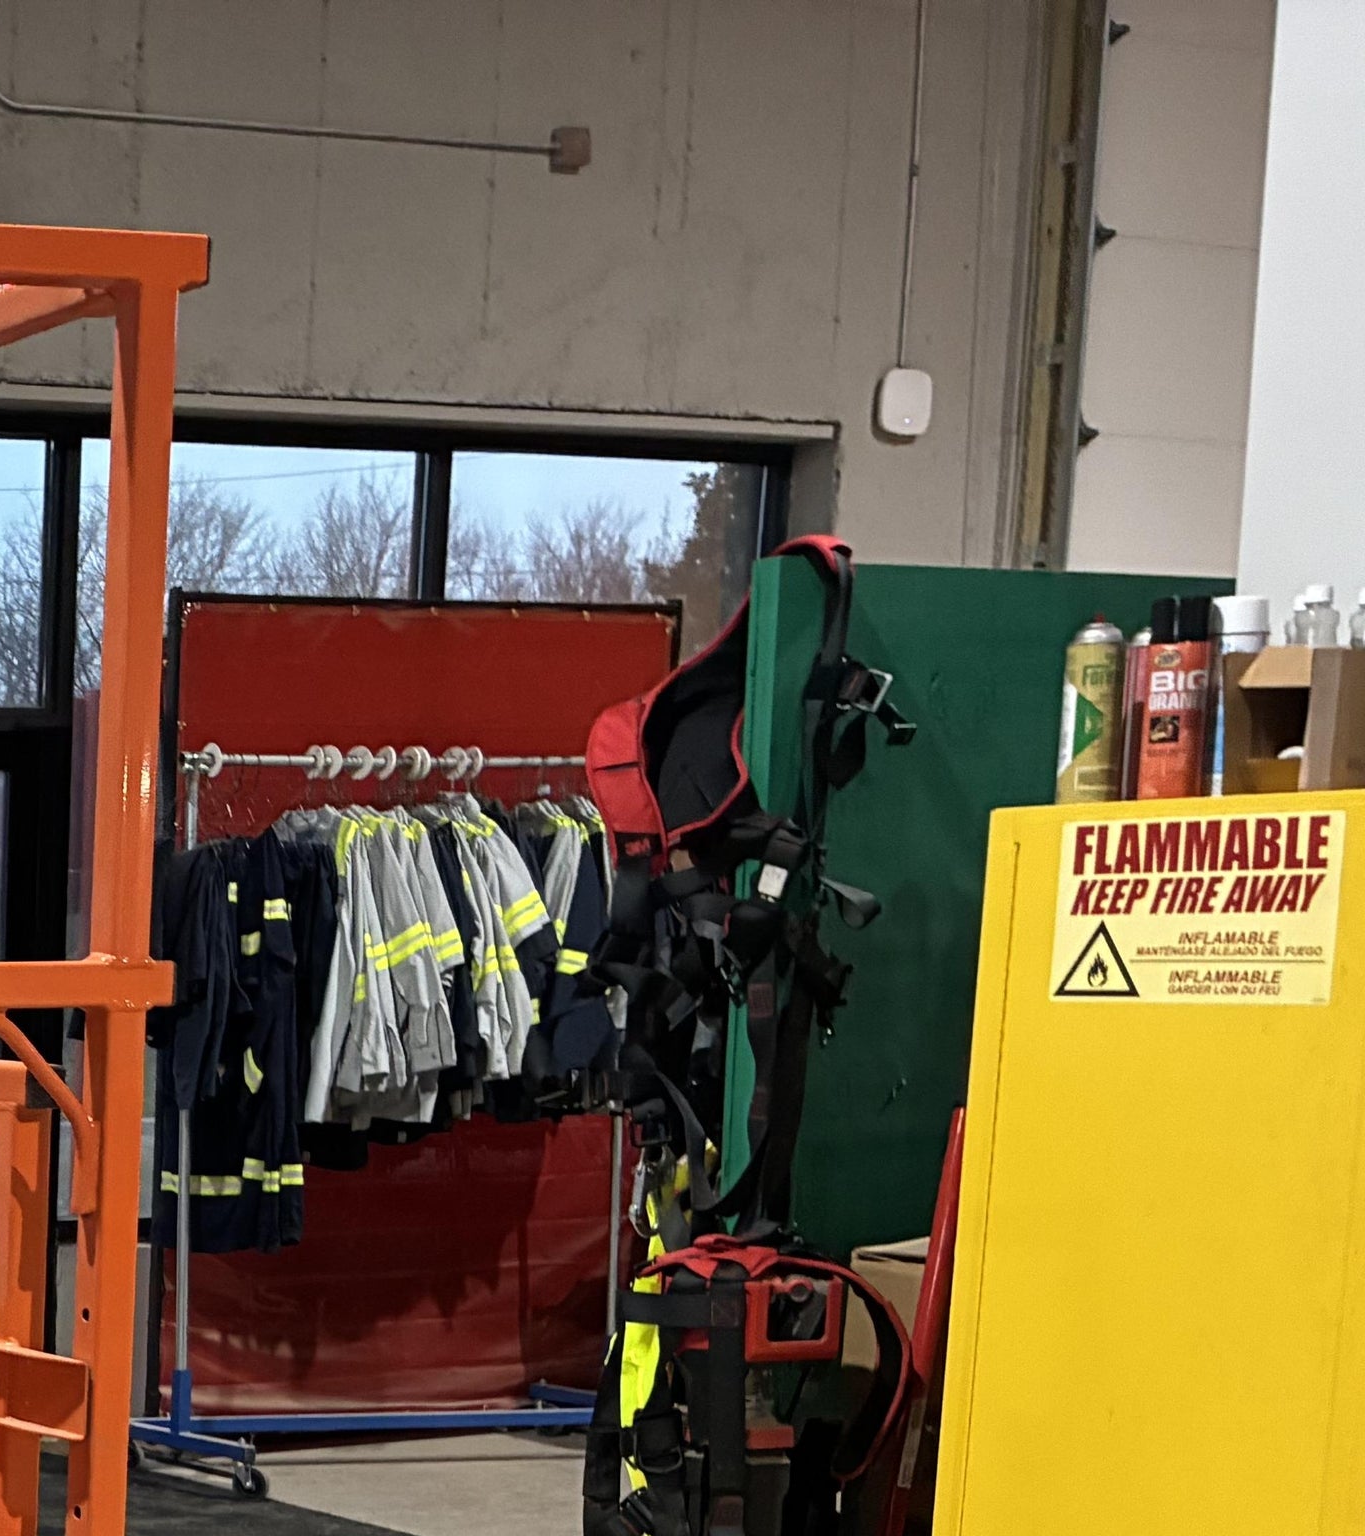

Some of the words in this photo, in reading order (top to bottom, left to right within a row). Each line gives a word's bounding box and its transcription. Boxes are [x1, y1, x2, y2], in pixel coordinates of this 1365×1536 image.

[1148, 690, 1199, 711] ORAN
[1073, 815, 1330, 876] FLAMMABLE
[1070, 879, 1149, 915] KEEP
[1150, 876, 1223, 914] FIRE
[1221, 874, 1326, 913] AWAY
[1178, 931, 1279, 945] INFLAMABLE
[1209, 946, 1258, 956] ALEJADO
[1261, 946, 1280, 956] DEL
[1284, 946, 1323, 956] FUEGO
[1168, 970, 1282, 984] INFLAMMABLE
[1168, 985, 1211, 995] GARDER
[1214, 985, 1238, 995] LOIN
[1241, 985, 1256, 995] DU
